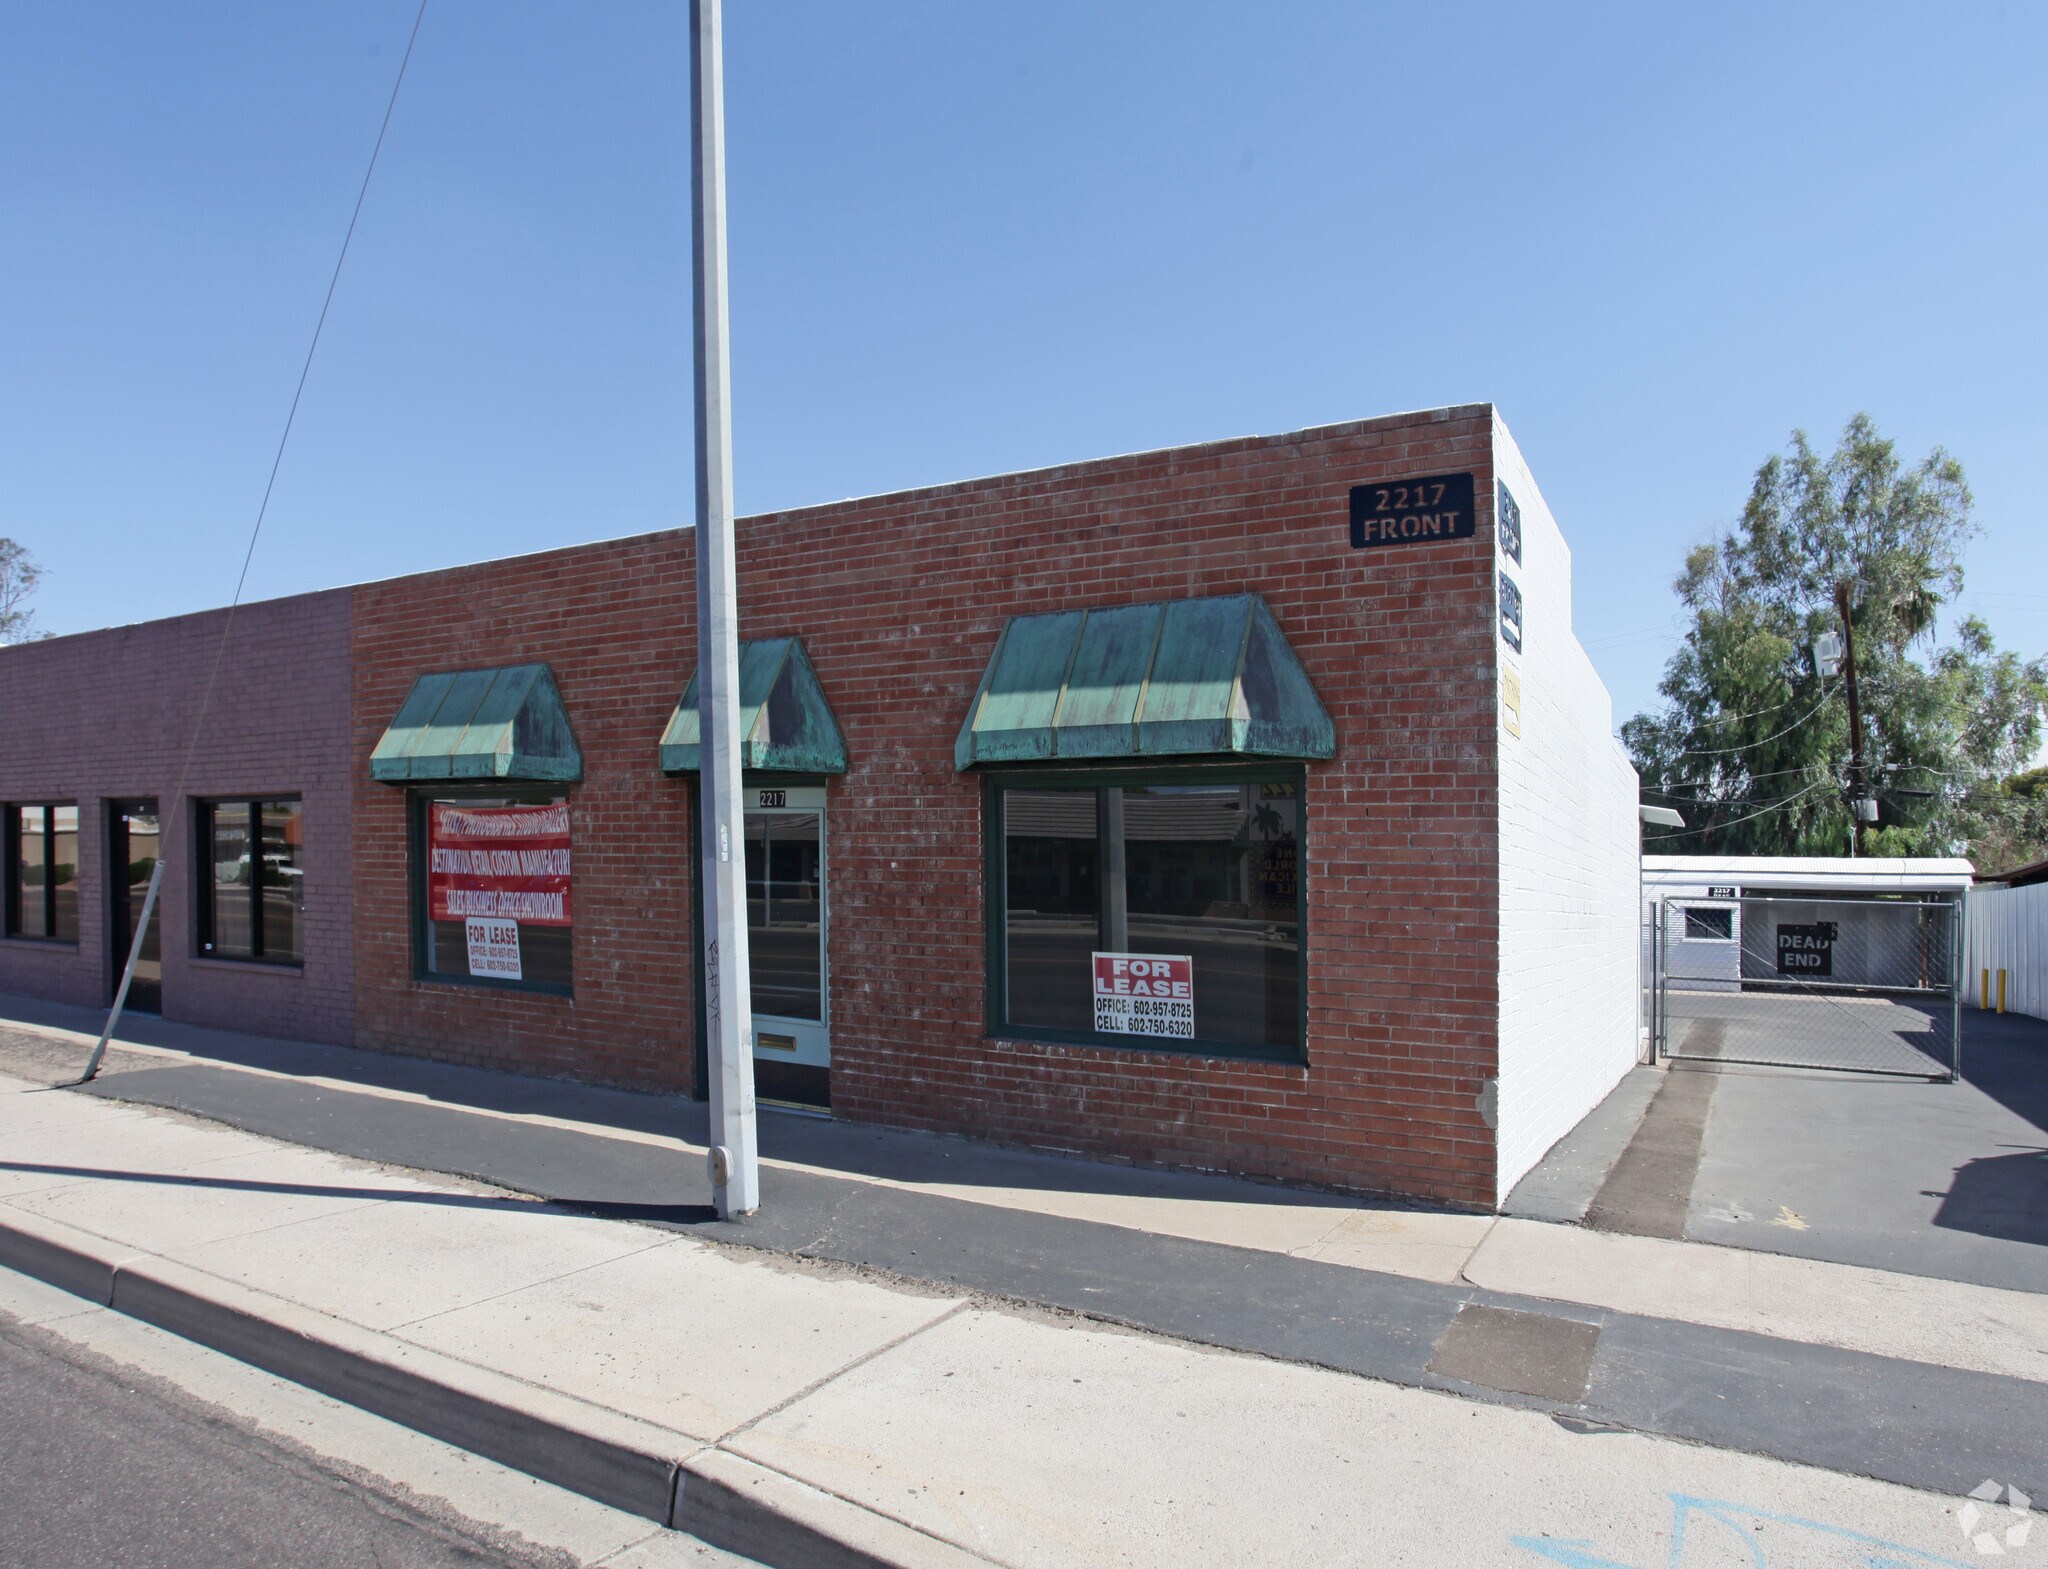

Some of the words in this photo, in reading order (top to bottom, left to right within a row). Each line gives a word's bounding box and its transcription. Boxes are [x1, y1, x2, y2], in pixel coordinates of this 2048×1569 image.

[1375, 483, 1446, 511] 2217
[1364, 511, 1460, 541] FRONT
[760, 792, 785, 806] 2217
[468, 925, 486, 943] FOR
[489, 926, 517, 945] LEASE
[1112, 959, 1171, 977] FOR
[1784, 952, 1821, 967] END
[1096, 977, 1190, 998] LEASE
[1096, 997, 1130, 1014] OFFICE:
[1133, 1000, 1192, 1018] 602-957-8725
[1096, 1015, 1124, 1031] CELL:
[1128, 1017, 1193, 1036] 602-750-6320
